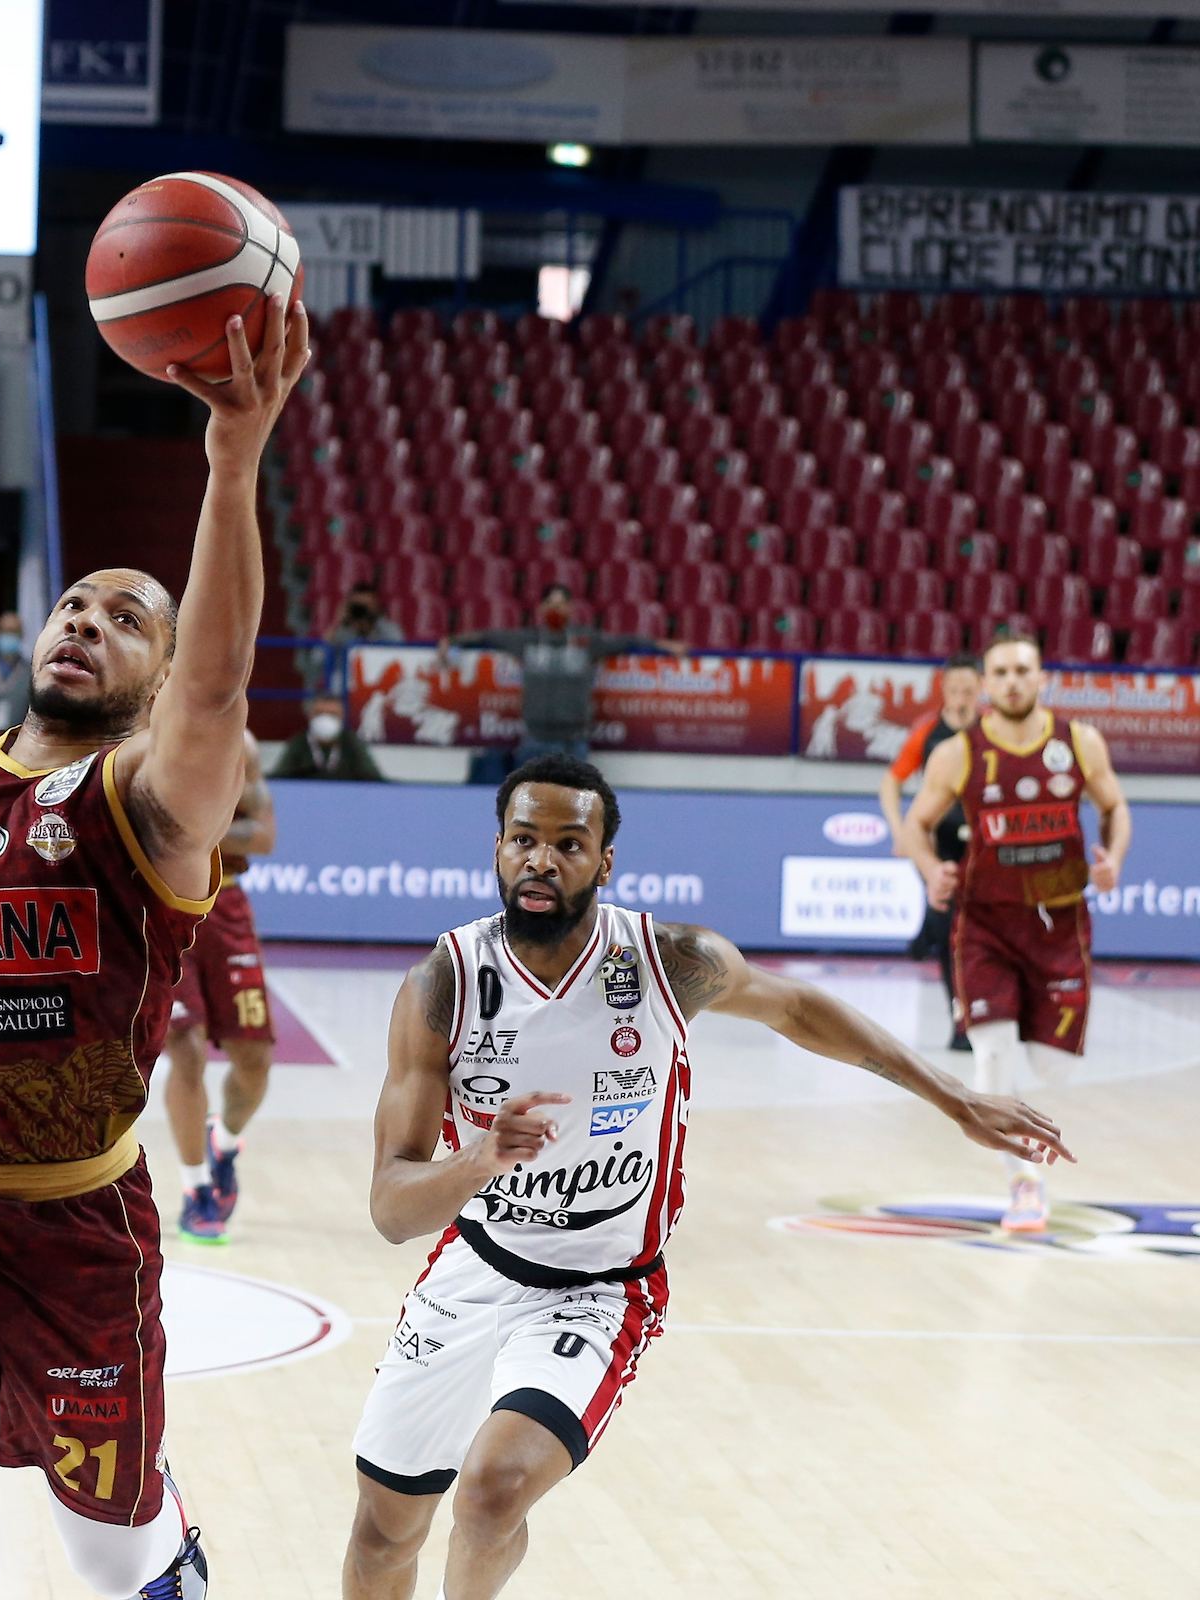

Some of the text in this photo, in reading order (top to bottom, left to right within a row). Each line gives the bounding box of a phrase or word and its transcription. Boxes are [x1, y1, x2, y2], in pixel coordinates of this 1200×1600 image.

[1012, 241, 1200, 292] PASSION
[986, 811, 1069, 840] UMANA
[232, 988, 266, 1028] 15
[463, 1030, 519, 1056] EA7
[593, 1086, 657, 1102] FRAGRANCES
[592, 1108, 638, 1131] SAP
[428, 1300, 457, 1320] Milano
[51, 1397, 121, 1418] UMANA
[52, 1433, 119, 1500] 21
